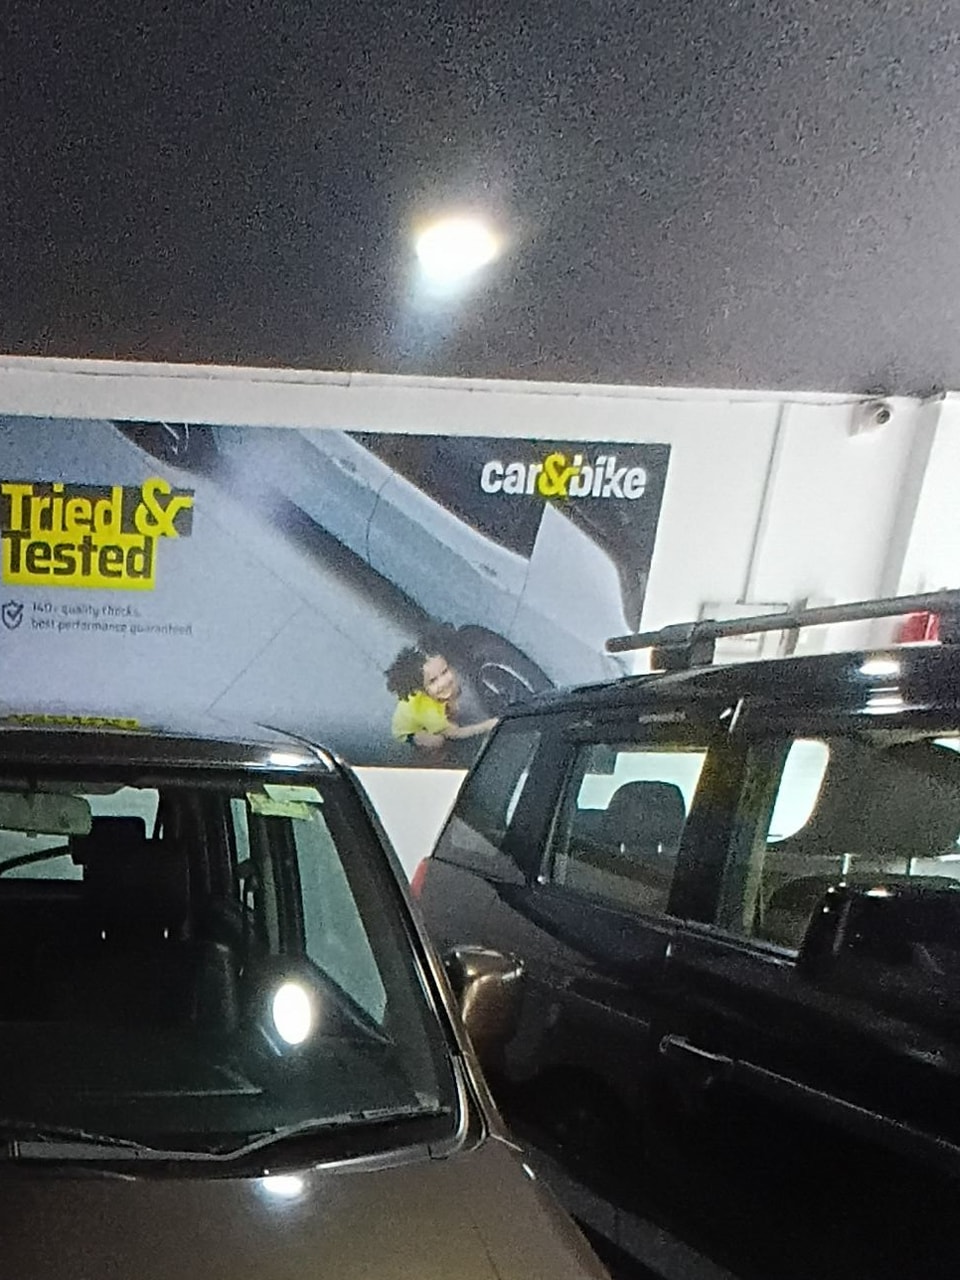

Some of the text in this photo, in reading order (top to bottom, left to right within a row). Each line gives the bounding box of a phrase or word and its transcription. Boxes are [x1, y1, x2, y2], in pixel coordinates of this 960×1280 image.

[480, 451, 647, 500] car&bike
[1, 477, 195, 538] Tried &
[1, 530, 154, 579] Tested
